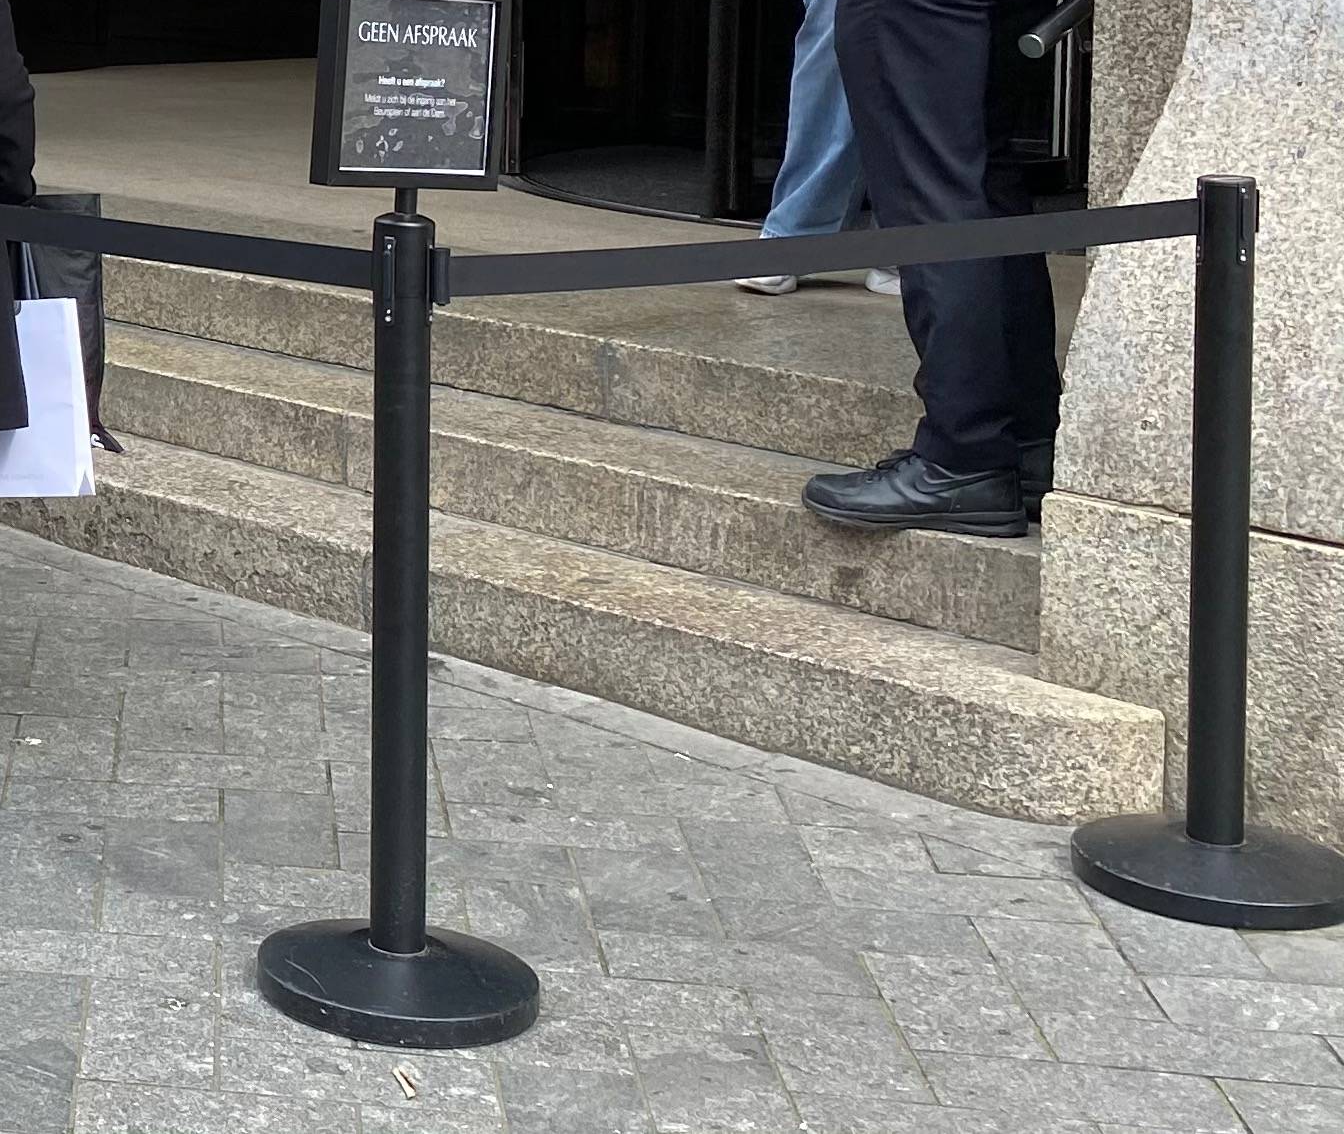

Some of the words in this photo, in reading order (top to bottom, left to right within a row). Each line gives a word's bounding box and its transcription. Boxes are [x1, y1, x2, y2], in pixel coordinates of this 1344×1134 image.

[358, 20, 400, 43] GEEN
[402, 23, 478, 48] AFSPRAAK
[378, 75, 396, 85] Heeft
[396, 78, 402, 86] u
[402, 78, 414, 86] een
[415, 77, 445, 88] afspraak?
